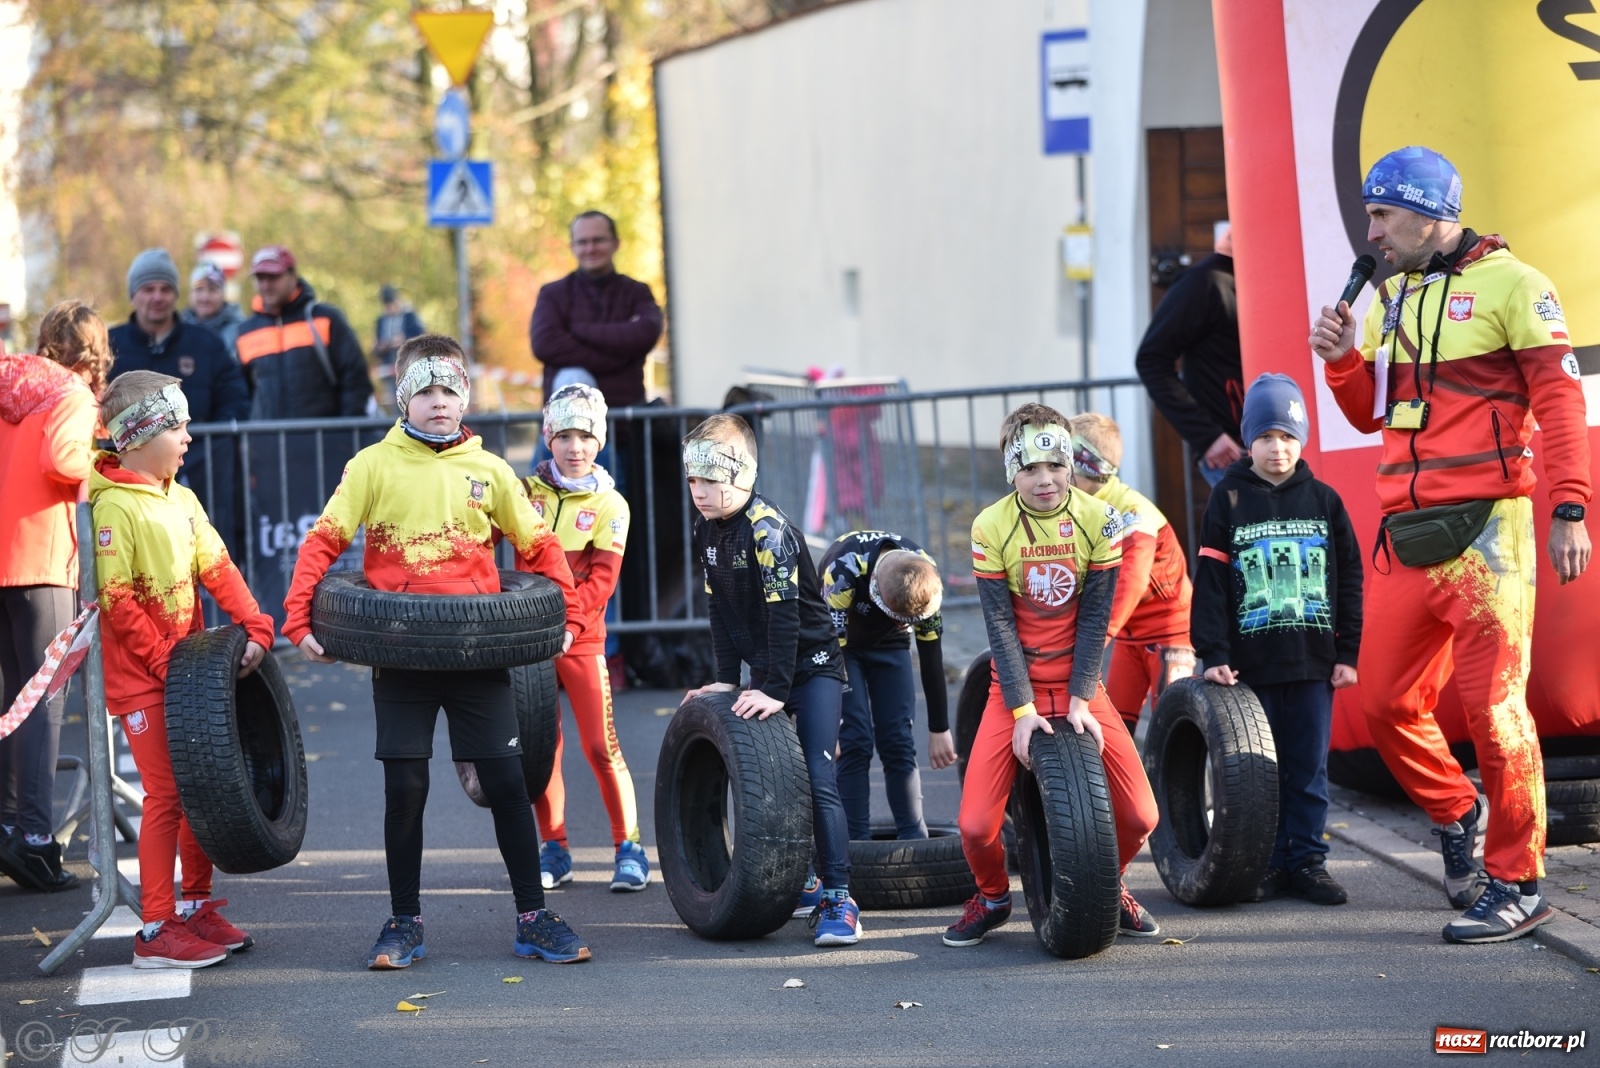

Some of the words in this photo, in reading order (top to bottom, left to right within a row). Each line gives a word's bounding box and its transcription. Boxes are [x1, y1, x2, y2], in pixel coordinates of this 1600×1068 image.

[1568, 360, 1578, 375] B
[1041, 436, 1052, 447] B
[1234, 520, 1329, 543] MINECRAFT
[1020, 542, 1077, 558] RACIBORKI
[765, 580, 789, 590] MORE
[1496, 903, 1527, 930] N
